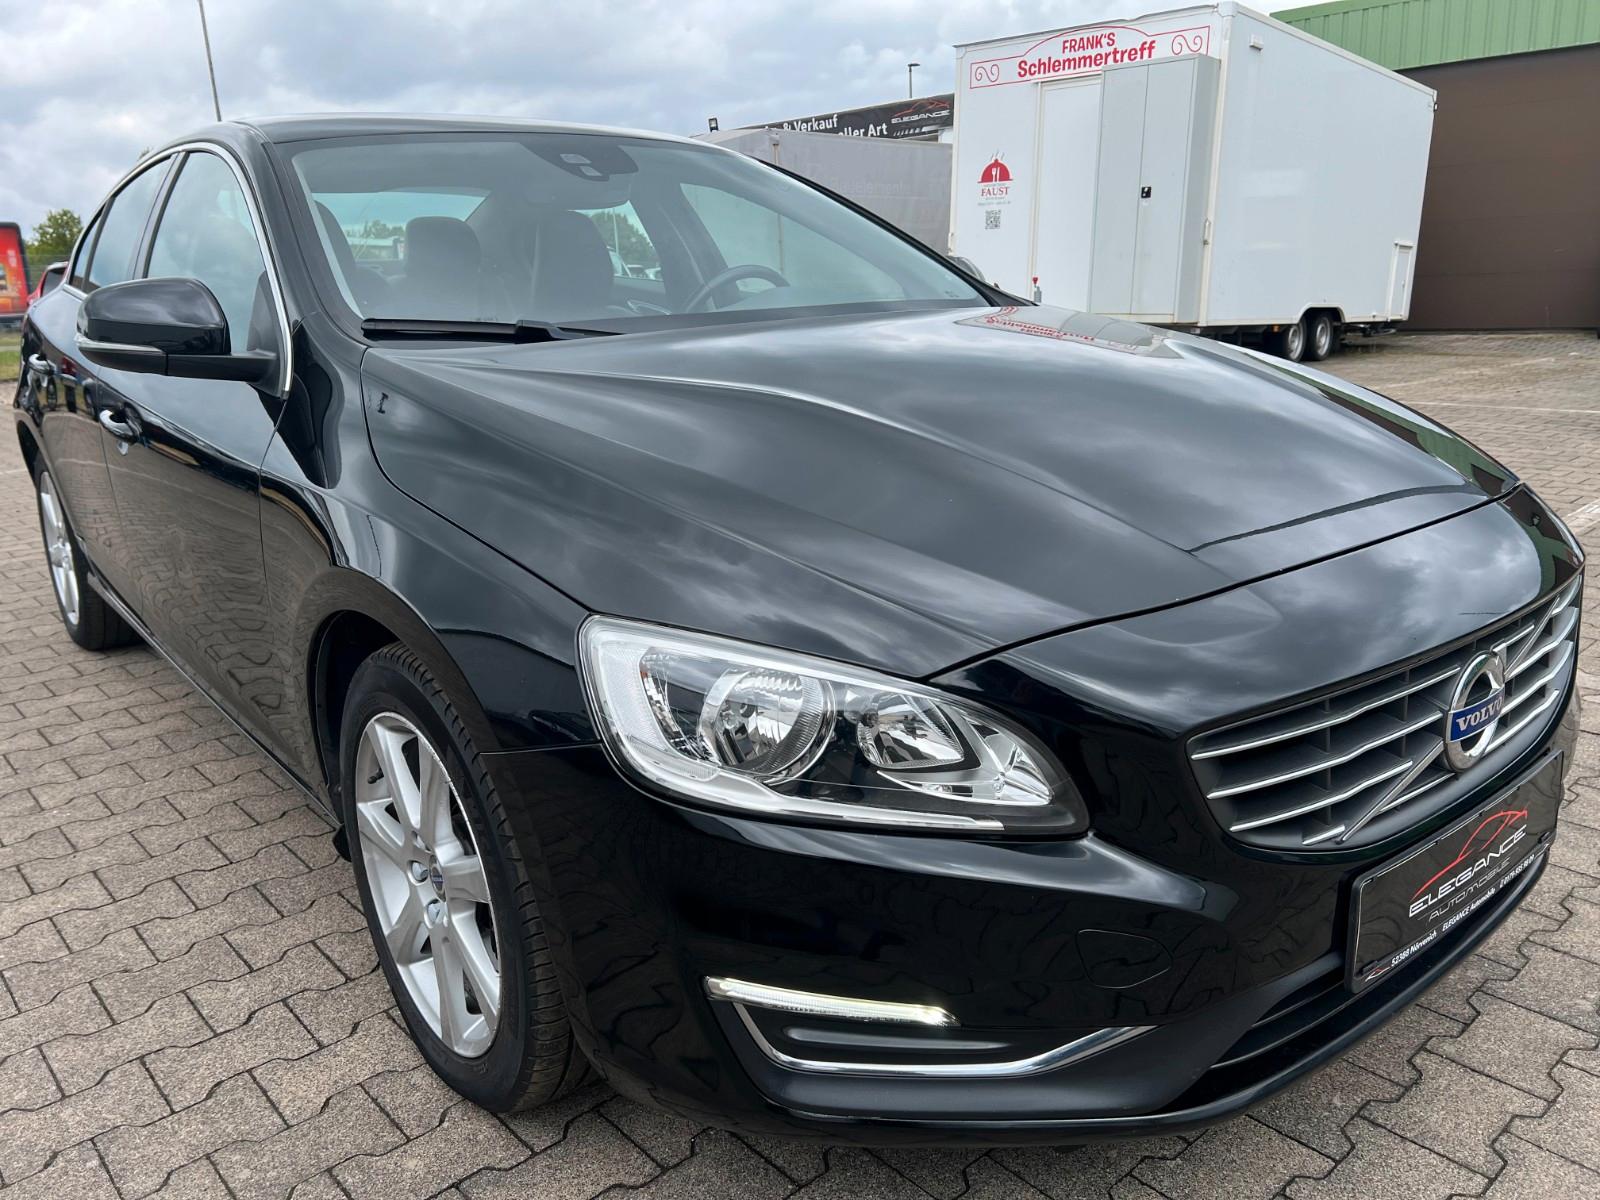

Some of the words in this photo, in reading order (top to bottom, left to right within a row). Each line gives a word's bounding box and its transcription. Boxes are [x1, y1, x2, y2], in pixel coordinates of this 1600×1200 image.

[1062, 32, 1116, 54] FRANK'S
[1018, 40, 1156, 77] Schlemmertreff
[793, 114, 838, 132] Verkauf
[891, 109, 951, 124] ELEGANCE
[868, 122, 888, 137] Art
[981, 186, 1010, 197] FAUST
[1456, 696, 1503, 731] VOLVO
[1409, 824, 1527, 918] ELEGANCE
[1429, 856, 1511, 922] AUTOMOBILE
